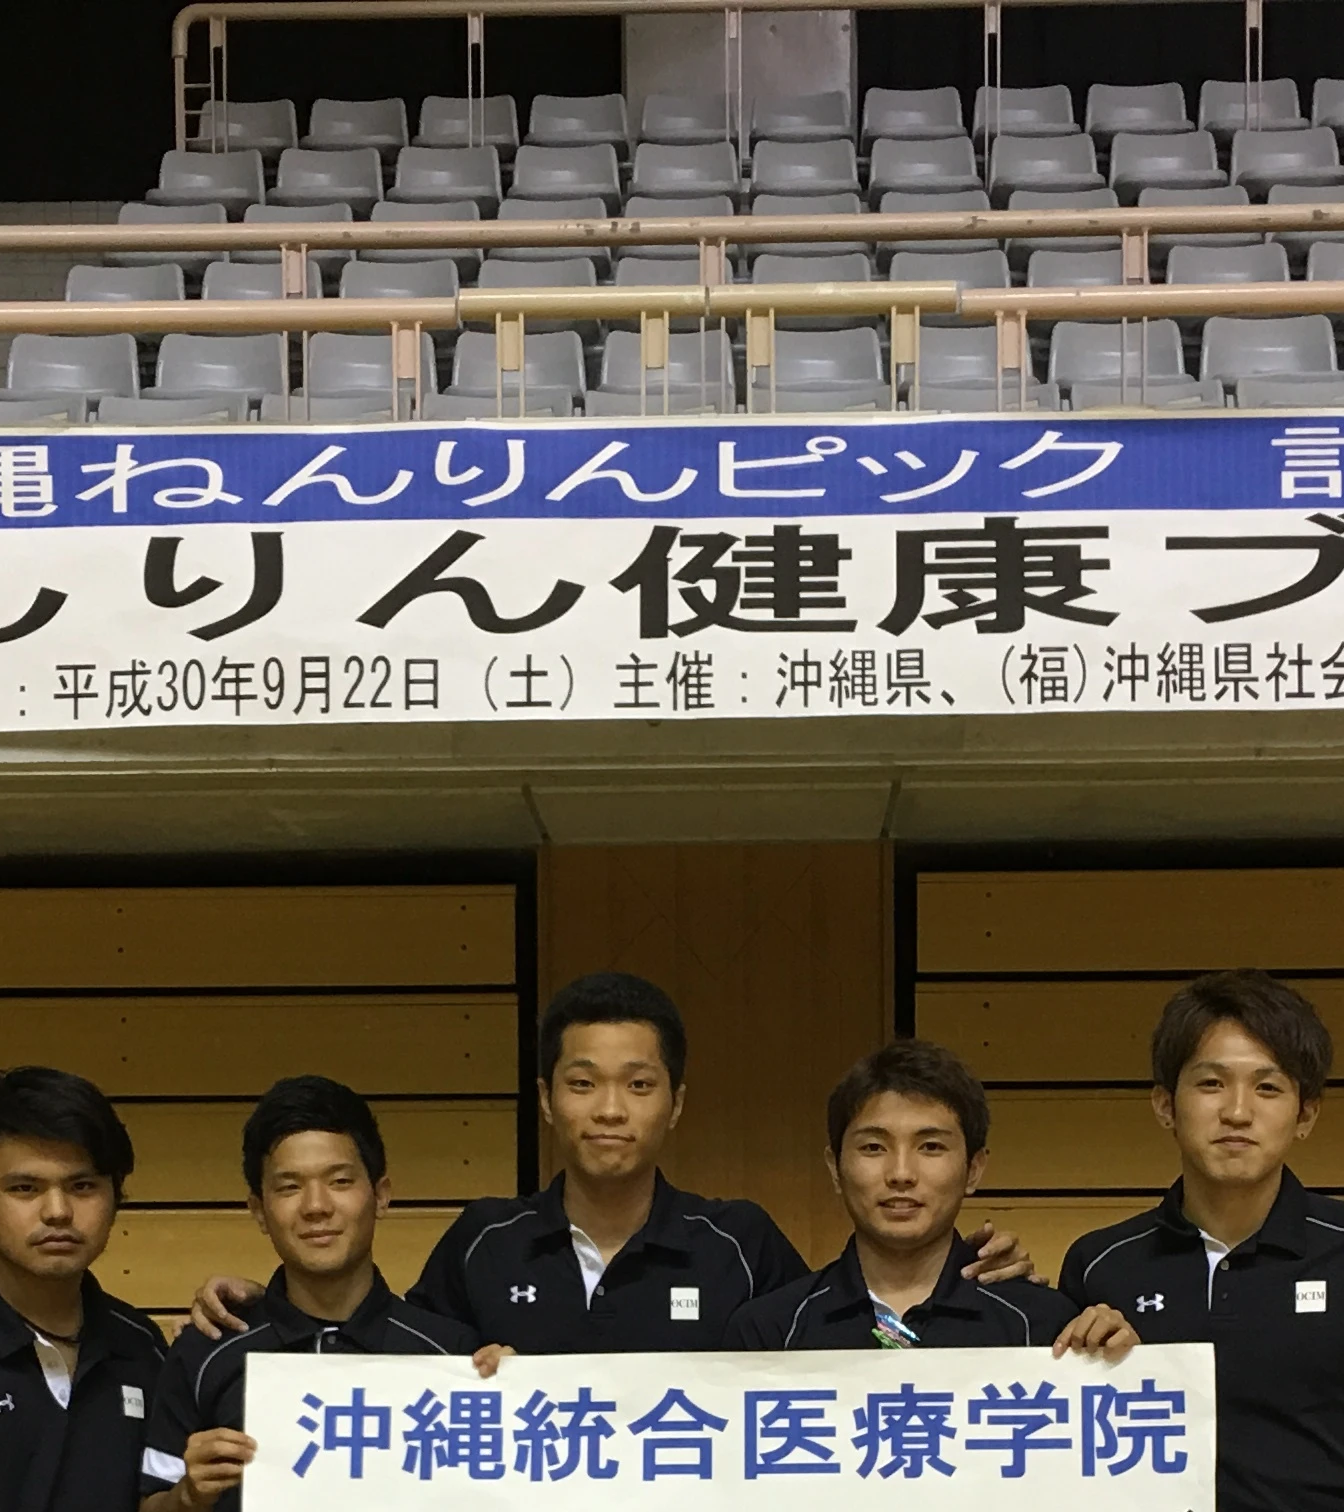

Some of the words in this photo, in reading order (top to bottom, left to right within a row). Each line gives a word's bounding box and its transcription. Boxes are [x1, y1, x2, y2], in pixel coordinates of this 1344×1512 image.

[294, 1380, 1187, 1481] 沖縄統合医療学院
